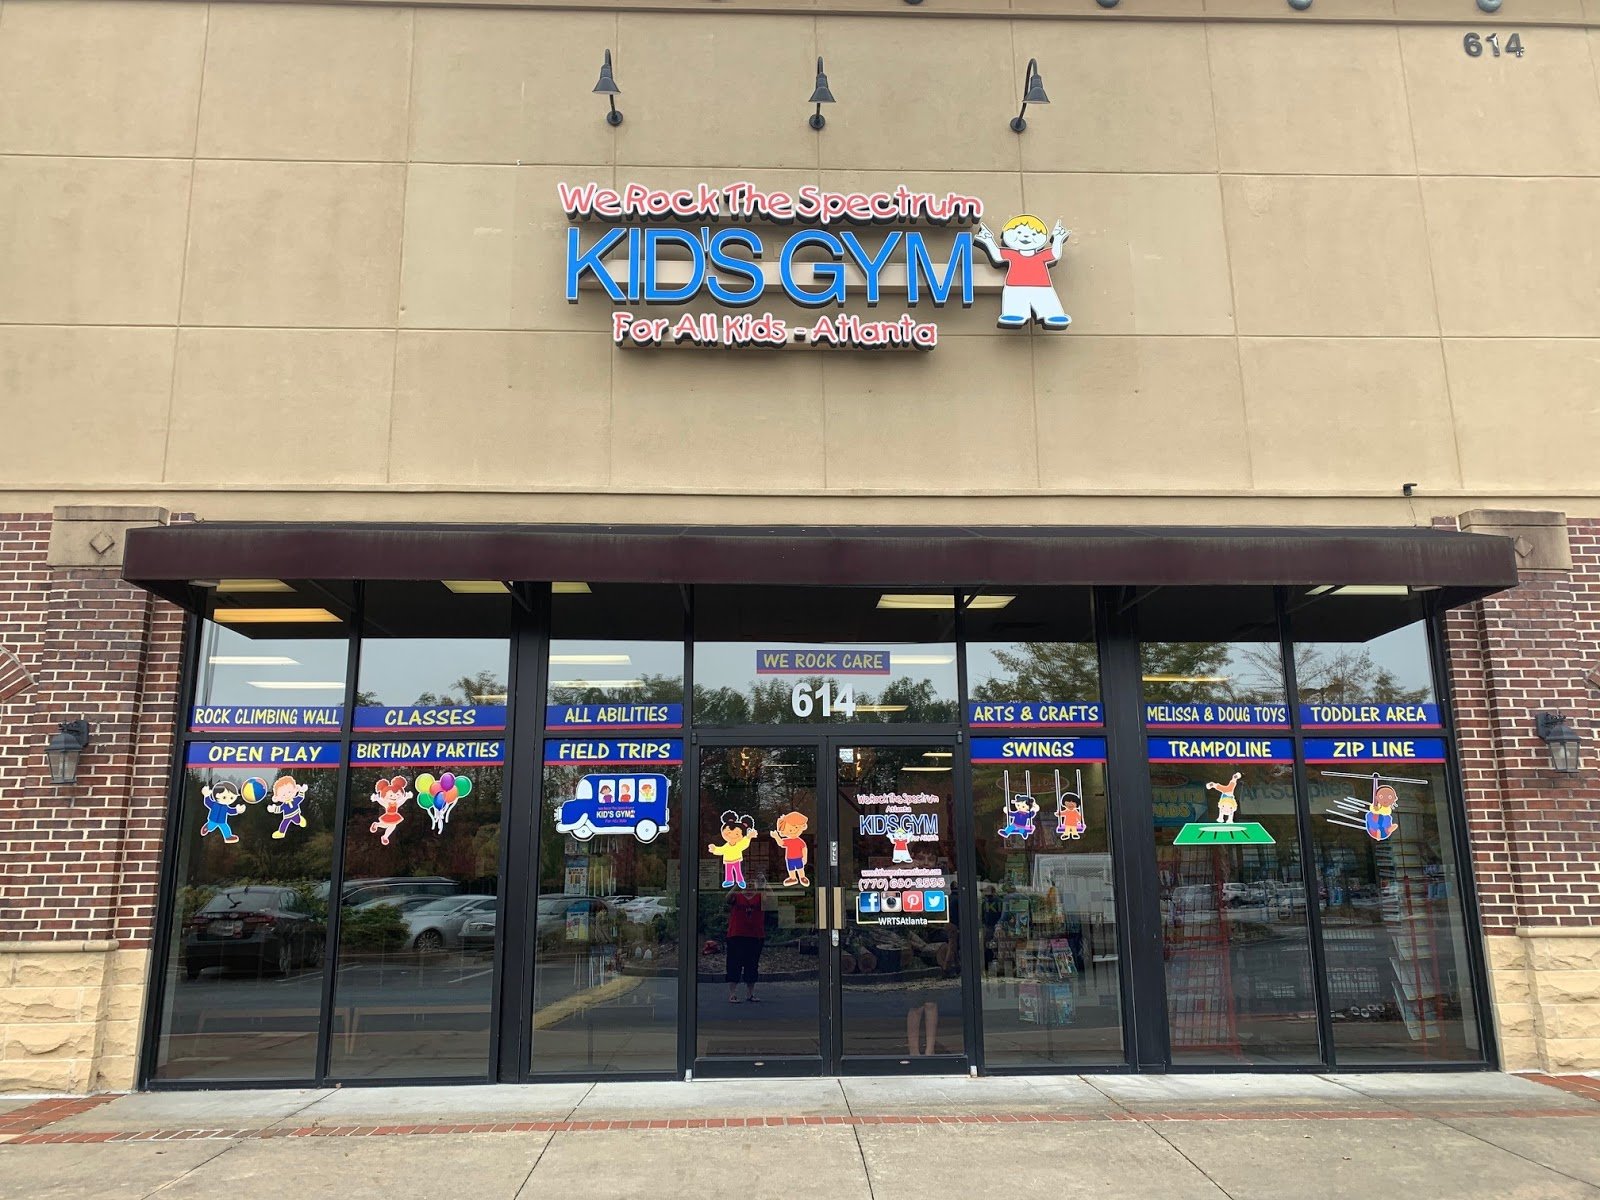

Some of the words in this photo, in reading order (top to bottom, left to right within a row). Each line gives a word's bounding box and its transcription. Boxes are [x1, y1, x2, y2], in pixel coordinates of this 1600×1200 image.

[1463, 32, 1525, 58] 614
[558, 183, 620, 216] We
[624, 183, 719, 216] Rock
[721, 182, 793, 218] The
[795, 186, 983, 224] Spectrum
[566, 227, 765, 304] KID'S
[779, 228, 974, 306] GYM
[612, 312, 668, 344] For
[673, 314, 718, 343] All
[721, 314, 786, 344] Kids
[811, 314, 938, 346] Atlanta
[763, 653, 790, 668] WE
[795, 653, 837, 668] ROCK
[842, 653, 884, 669] CARE
[791, 683, 856, 717] 614
[195, 708, 231, 725] ROCK
[235, 708, 298, 725] CLIMBING
[303, 708, 340, 725] WALL
[384, 709, 476, 726] CLASSES
[564, 706, 592, 723] ALL
[597, 705, 668, 723] ABILITIES
[974, 705, 1015, 722] ARTS
[1021, 706, 1034, 722] &
[1039, 705, 1099, 722] CRAFTS
[1147, 705, 1200, 722] MELISSA
[1203, 706, 1215, 722] &
[1218, 706, 1251, 723] DOUG
[1255, 707, 1286, 723] TOYS
[1311, 706, 1380, 722] TODDLER
[1385, 707, 1427, 722] AREA
[208, 746, 264, 762] OPEN
[270, 746, 323, 762] PLAY
[356, 743, 431, 759] BIRTHDAY
[436, 742, 499, 758] PARTIES
[559, 742, 610, 760] FIELD
[617, 742, 671, 759] TRIPS
[1002, 740, 1075, 758] SWINGS
[1167, 740, 1273, 758] TRAMPOLINE
[1333, 741, 1364, 758] ZIP
[1371, 741, 1416, 758] LINE
[596, 810, 614, 819] KID'S
[615, 810, 631, 819] GYM
[859, 814, 899, 836] KID'S
[900, 814, 939, 836] GYM
[858, 878, 889, 892] (770)
[878, 916, 928, 926] WRTSAtlanta
